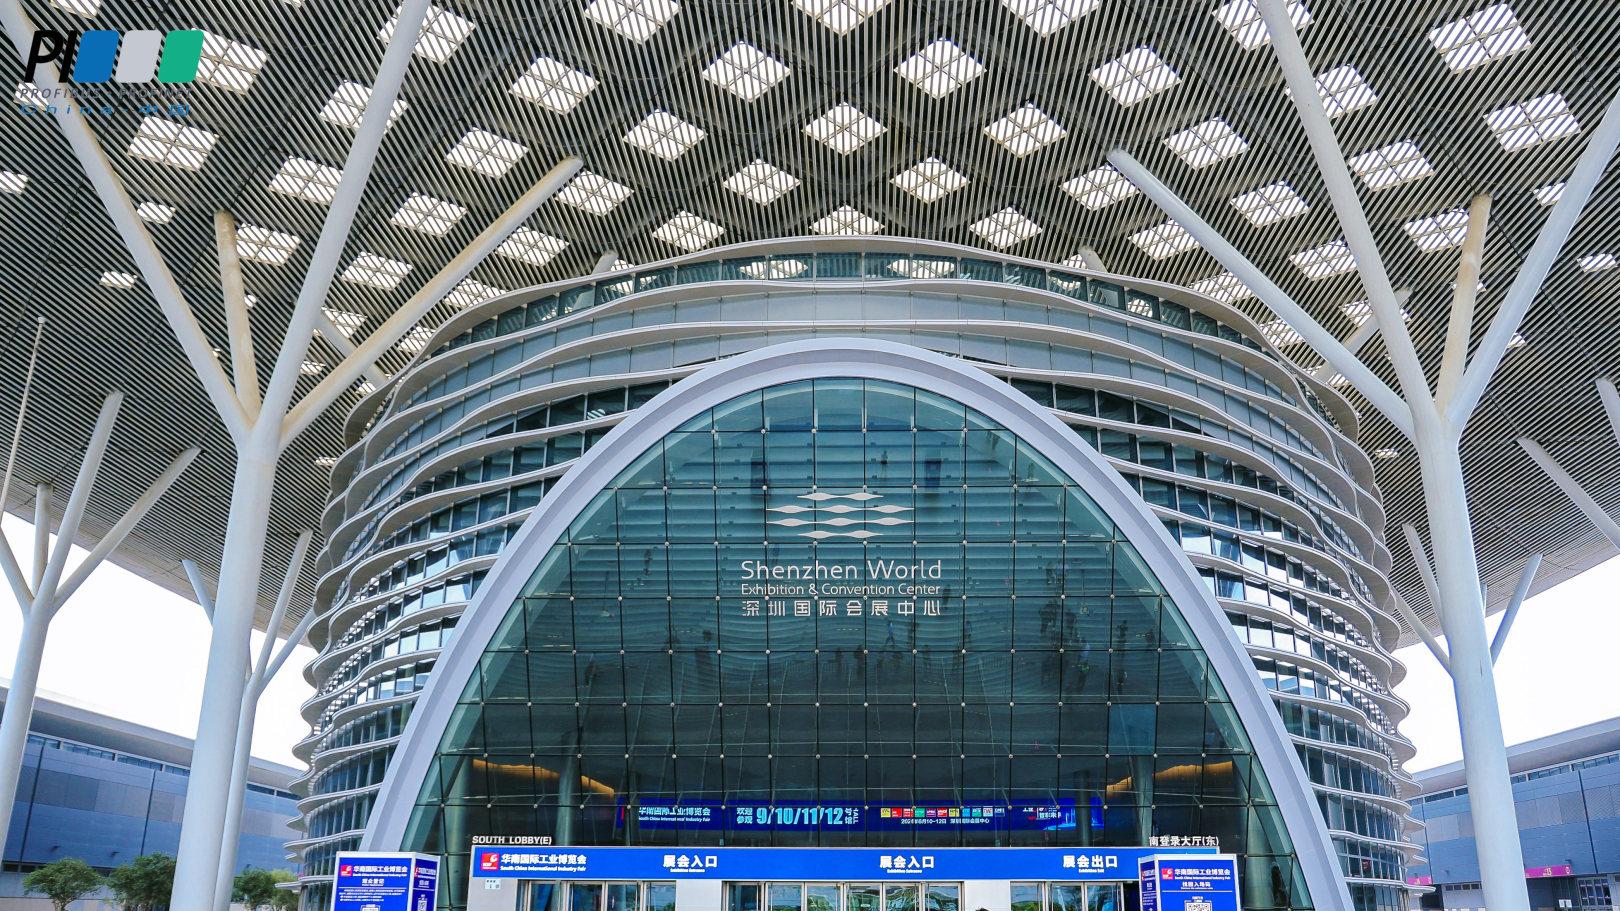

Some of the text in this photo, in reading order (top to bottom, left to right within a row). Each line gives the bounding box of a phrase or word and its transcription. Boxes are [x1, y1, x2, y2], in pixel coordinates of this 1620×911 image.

[741, 560, 942, 579] Shenzhen World
[741, 583, 940, 595] Exhibition & Convention Center
[742, 600, 941, 617] 深圳国际会展中心
[736, 807, 753, 815] 欢迎
[756, 807, 843, 824] 9/10/11/12
[736, 815, 753, 824] 参观
[472, 836, 552, 845] SOUTH LOBBY(E)
[1149, 836, 1219, 846] 南登录大厅(东)
[501, 854, 587, 865] 华南国际工业博览会
[663, 854, 718, 868] 展会入口
[880, 855, 935, 868] 展会入口
[1063, 854, 1118, 868] 展会出口
